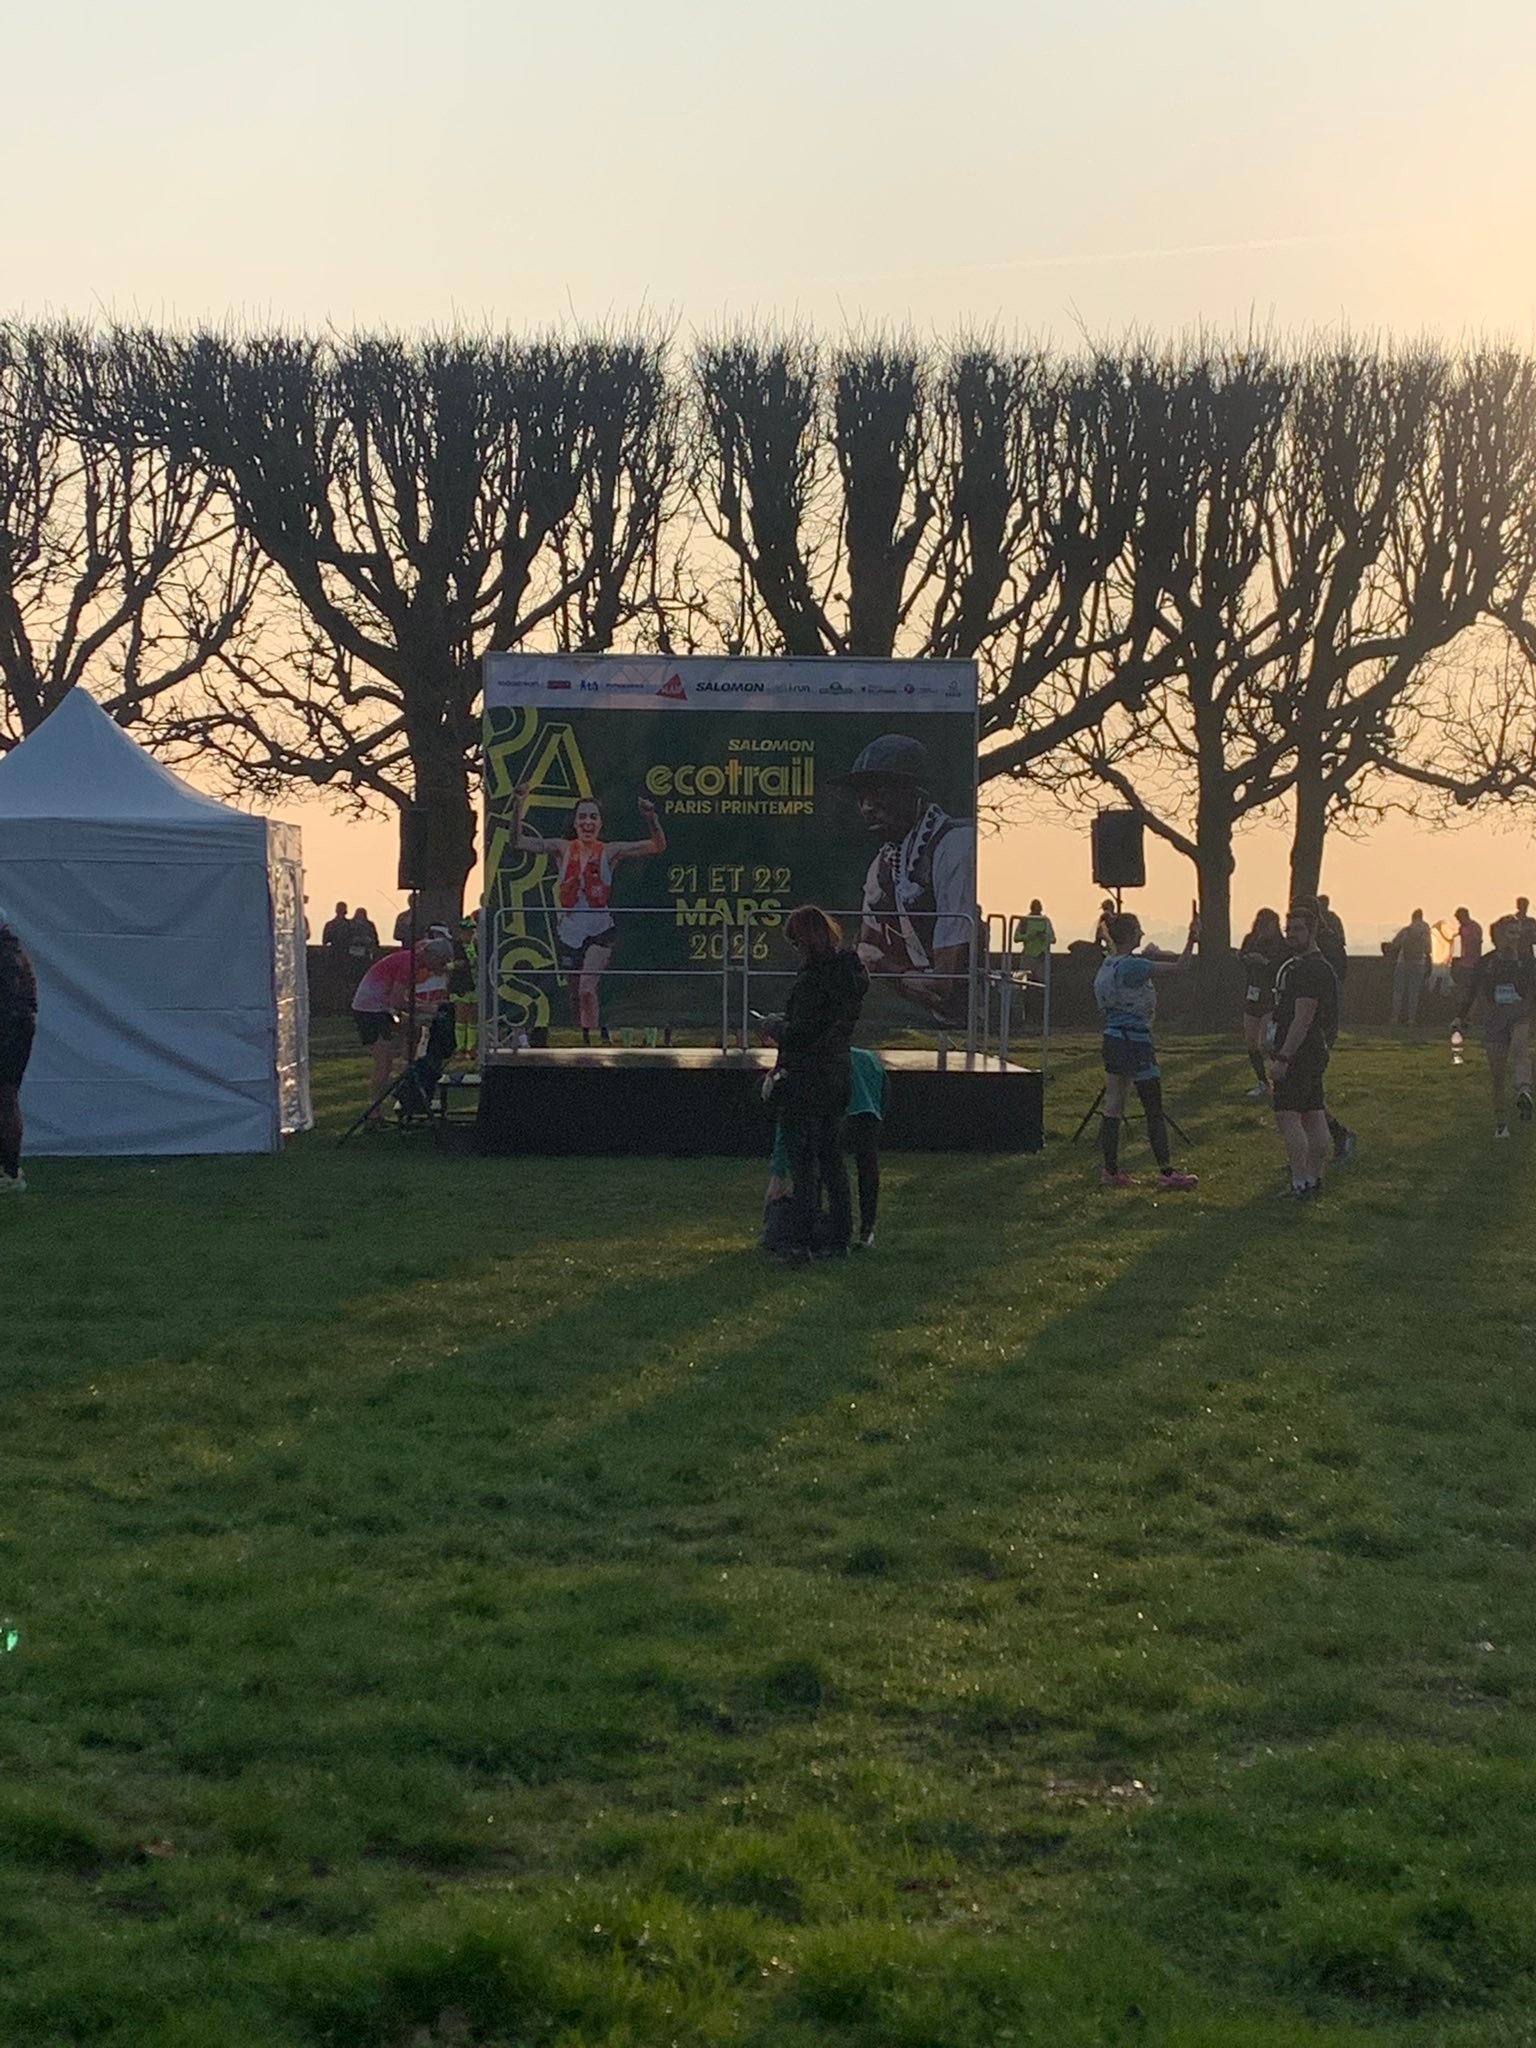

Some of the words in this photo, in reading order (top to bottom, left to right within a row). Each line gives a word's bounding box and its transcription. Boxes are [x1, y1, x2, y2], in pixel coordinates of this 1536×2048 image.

[695, 682, 765, 692] SALOMON
[728, 739, 815, 751] SALOMON
[645, 756, 815, 797] ecotrail
[665, 801, 712, 814] PARIS
[721, 801, 814, 815] PRINTEMPS
[668, 865, 698, 893] 21
[709, 866, 745, 893] ET
[753, 866, 792, 893] 22
[675, 898, 782, 926] MARS
[690, 932, 769, 960] 2026
